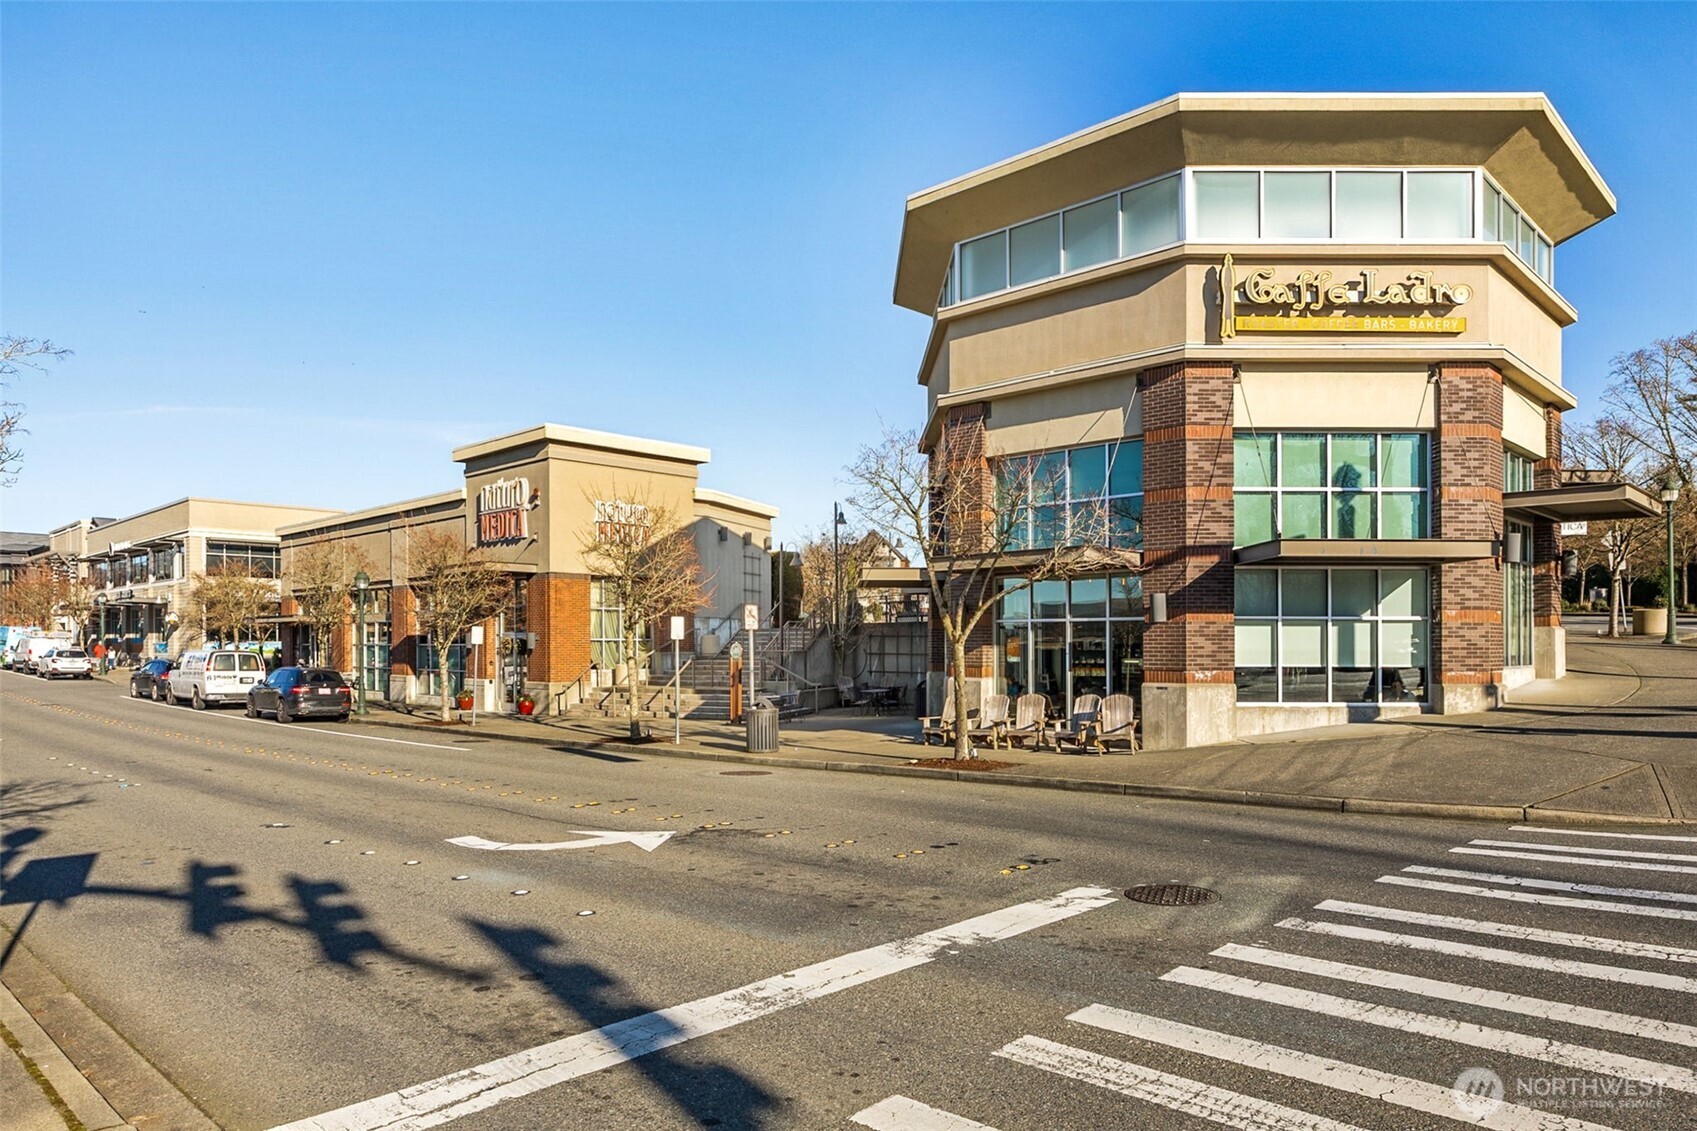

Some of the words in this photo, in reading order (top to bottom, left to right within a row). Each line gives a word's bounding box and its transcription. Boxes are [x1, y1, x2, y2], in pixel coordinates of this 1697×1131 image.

[1361, 268, 1474, 305] Ladro
[1364, 320, 1397, 330] BARS
[1409, 320, 1459, 330] BAKERY
